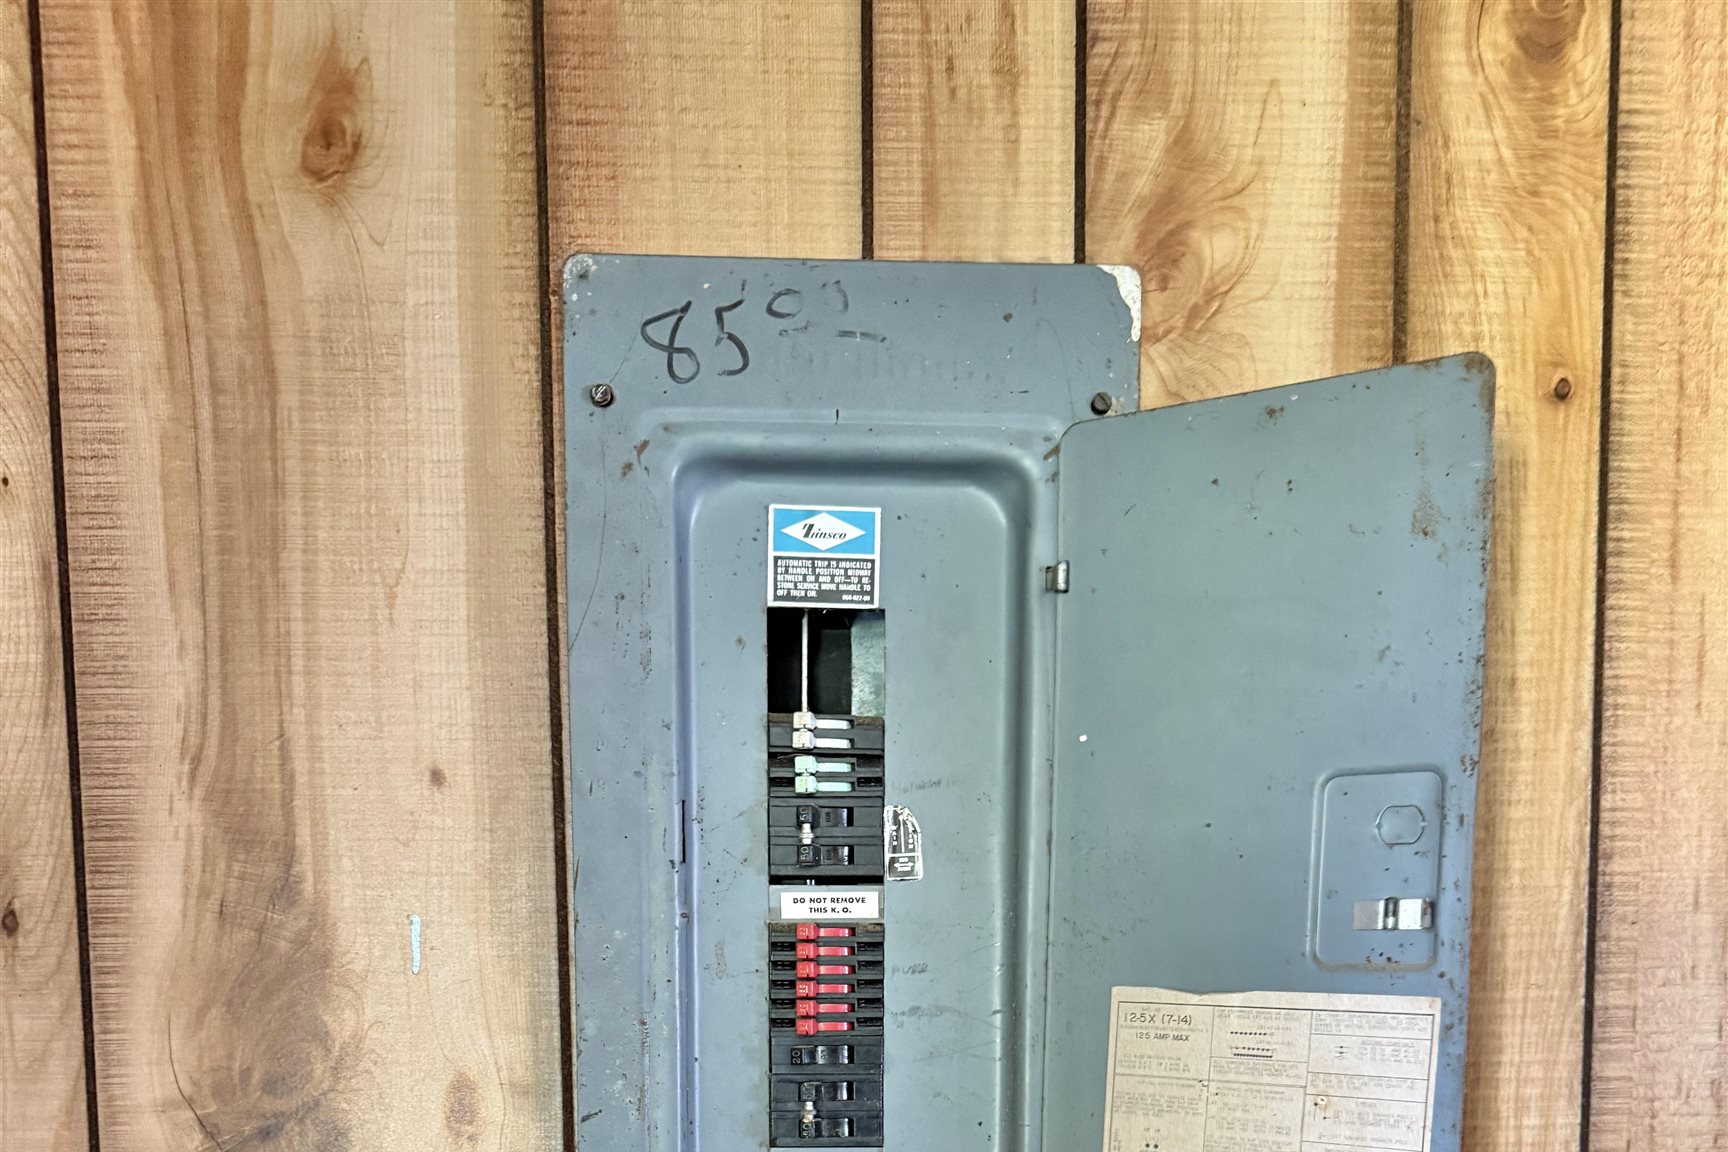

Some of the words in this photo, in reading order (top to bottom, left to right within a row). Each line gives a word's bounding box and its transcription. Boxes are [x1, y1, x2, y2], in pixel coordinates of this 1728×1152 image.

[802, 523, 847, 540] Zinsco
[777, 559, 812, 567] AUTOMATIC
[814, 560, 828, 568] TRIP
[839, 561, 872, 569] INDICATED
[776, 574, 803, 582] BETWEEN
[816, 568, 844, 576] POSITION
[848, 569, 871, 577] MIDWAY
[797, 582, 819, 590] SERVICE
[821, 583, 837, 591] MOVE
[800, 807, 809, 821] 50
[800, 846, 809, 860] 50
[830, 896, 866, 904] REMOVE
[1161, 1013, 1192, 1026] (7-14)
[1135, 1031, 1151, 1039] 125
[1172, 1034, 1190, 1042] MAX
[792, 1050, 801, 1064] 20
